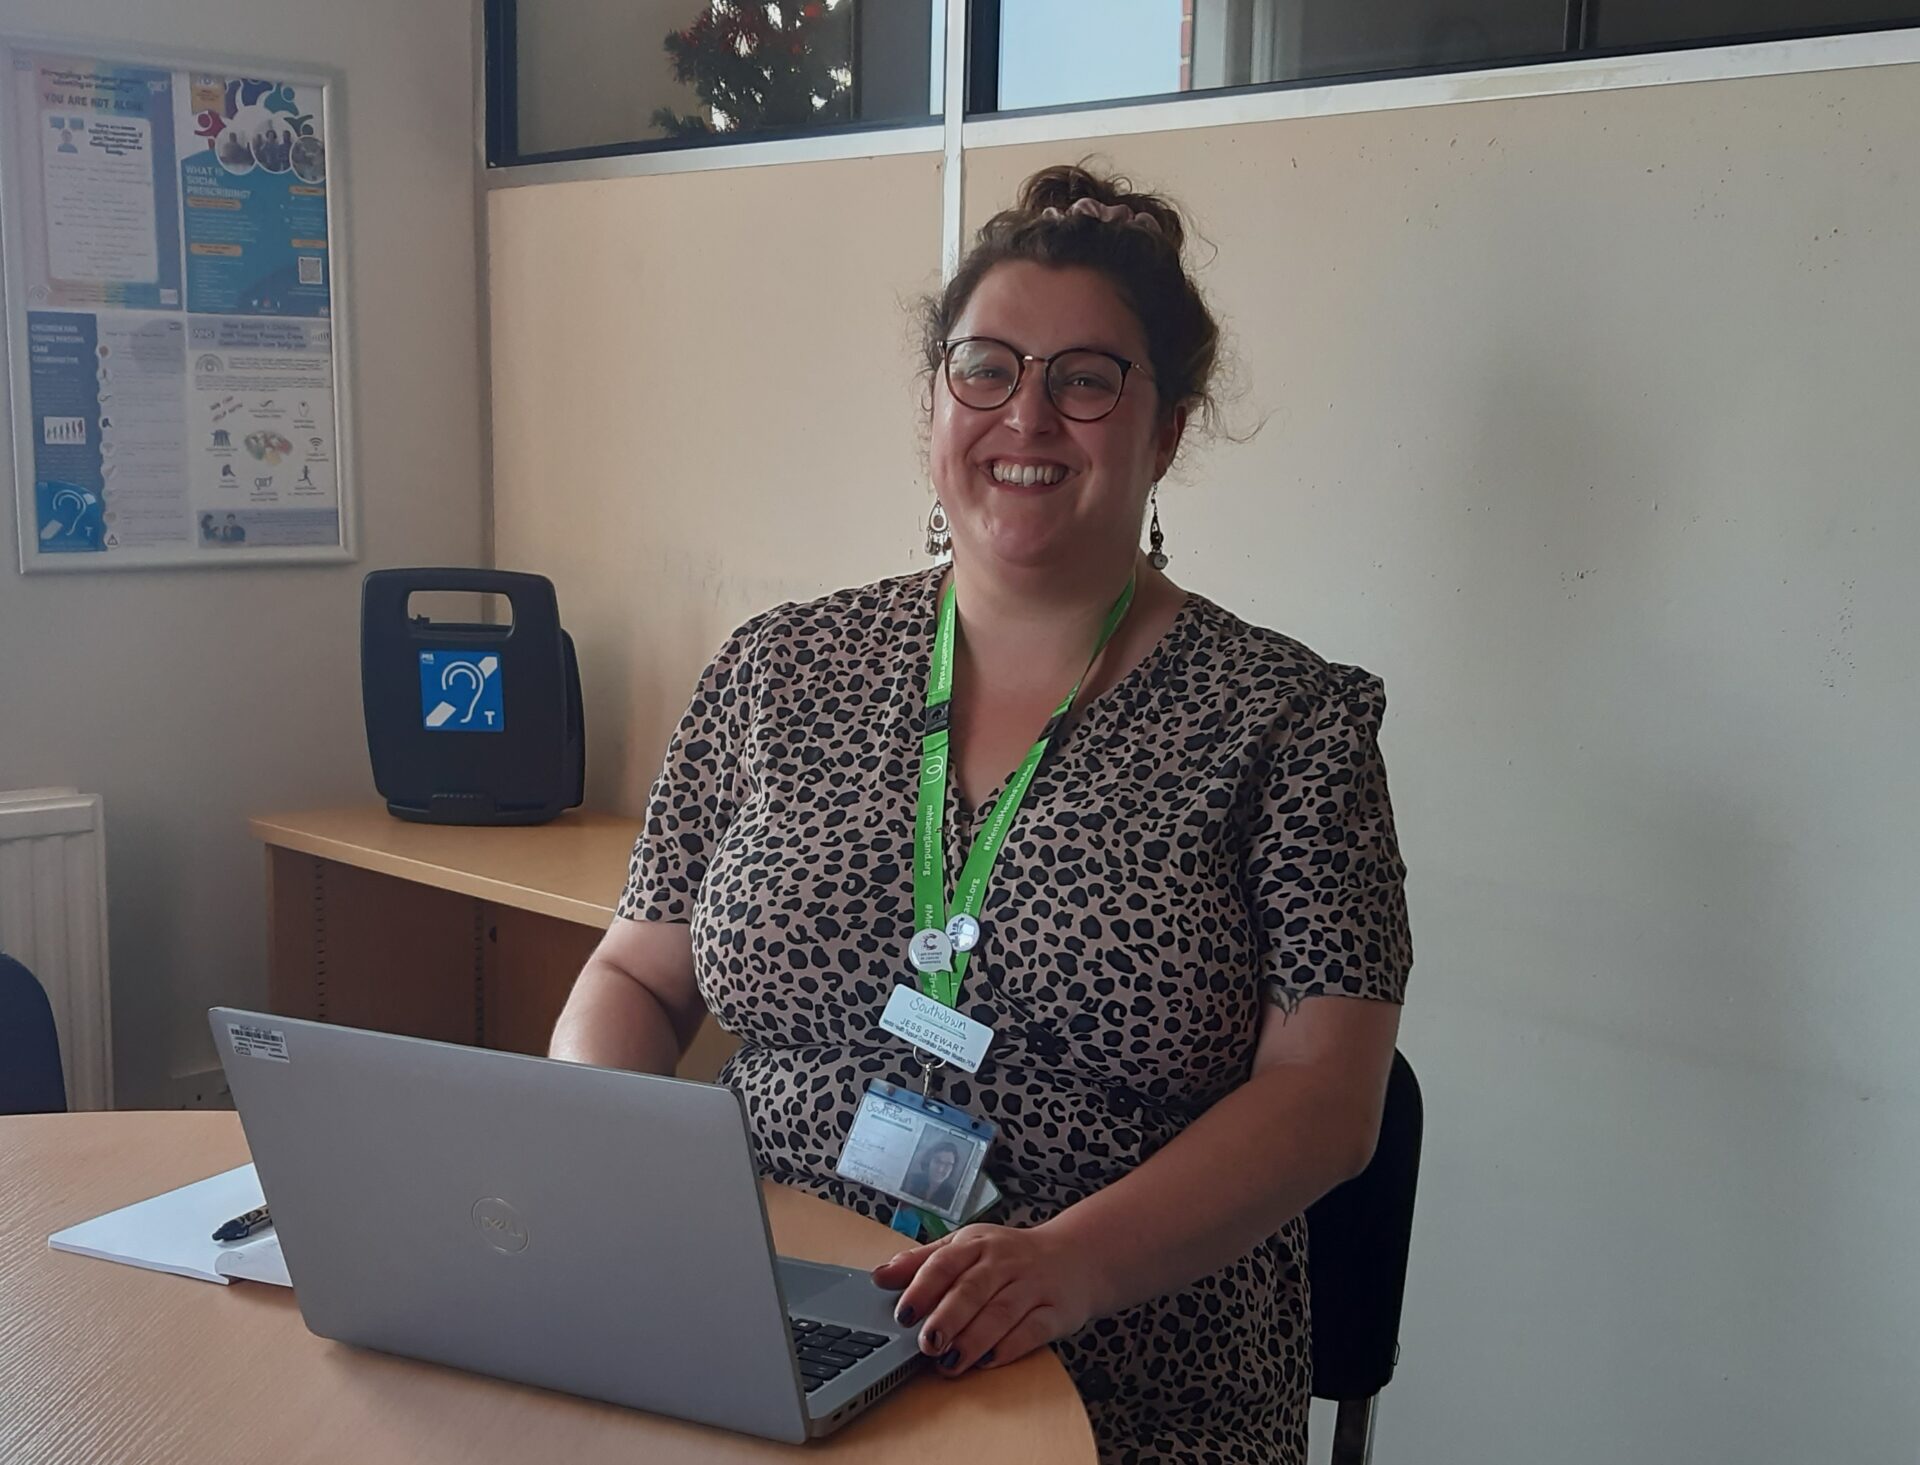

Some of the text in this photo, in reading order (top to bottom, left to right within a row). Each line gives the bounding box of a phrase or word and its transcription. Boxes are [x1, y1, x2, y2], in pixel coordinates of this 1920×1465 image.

[44, 93, 64, 104] YOU
[67, 95, 87, 106] ARE
[90, 97, 109, 108] NOT
[185, 165, 213, 176] WHAT
[186, 175, 218, 187] SOCIAL
[187, 185, 251, 201] PRESCRIBING?
[484, 711, 495, 725] T
[909, 997, 966, 1031] Southdown
[900, 1018, 965, 1053] JESS STEWART
